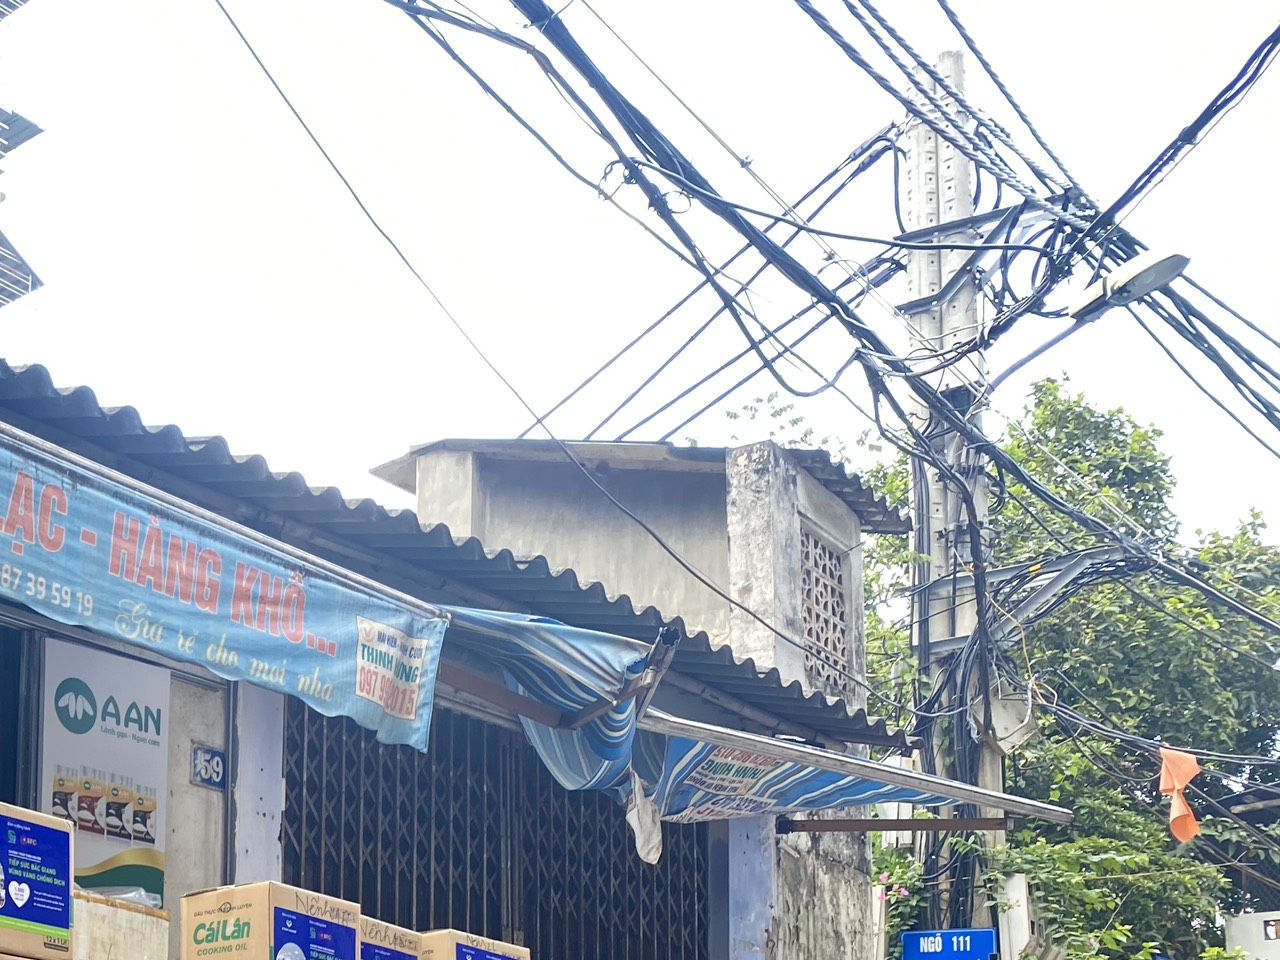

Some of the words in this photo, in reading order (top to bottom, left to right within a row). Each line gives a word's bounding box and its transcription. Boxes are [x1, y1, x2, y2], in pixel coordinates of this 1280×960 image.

[108, 510, 222, 615] HÀNG
[26, 571, 47, 597] 39
[51, 581, 72, 610] 59
[76, 592, 94, 617] 19
[114, 597, 164, 645] Giá
[205, 636, 239, 667] cho
[250, 652, 286, 690] mọi
[297, 666, 333, 702] nhà
[101, 695, 161, 735] AAN
[132, 734, 147, 745] Ngon
[197, 945, 233, 957] COOKING
[235, 942, 248, 951] OIL
[919, 933, 942, 953] NGÕ
[952, 936, 971, 952] 111
